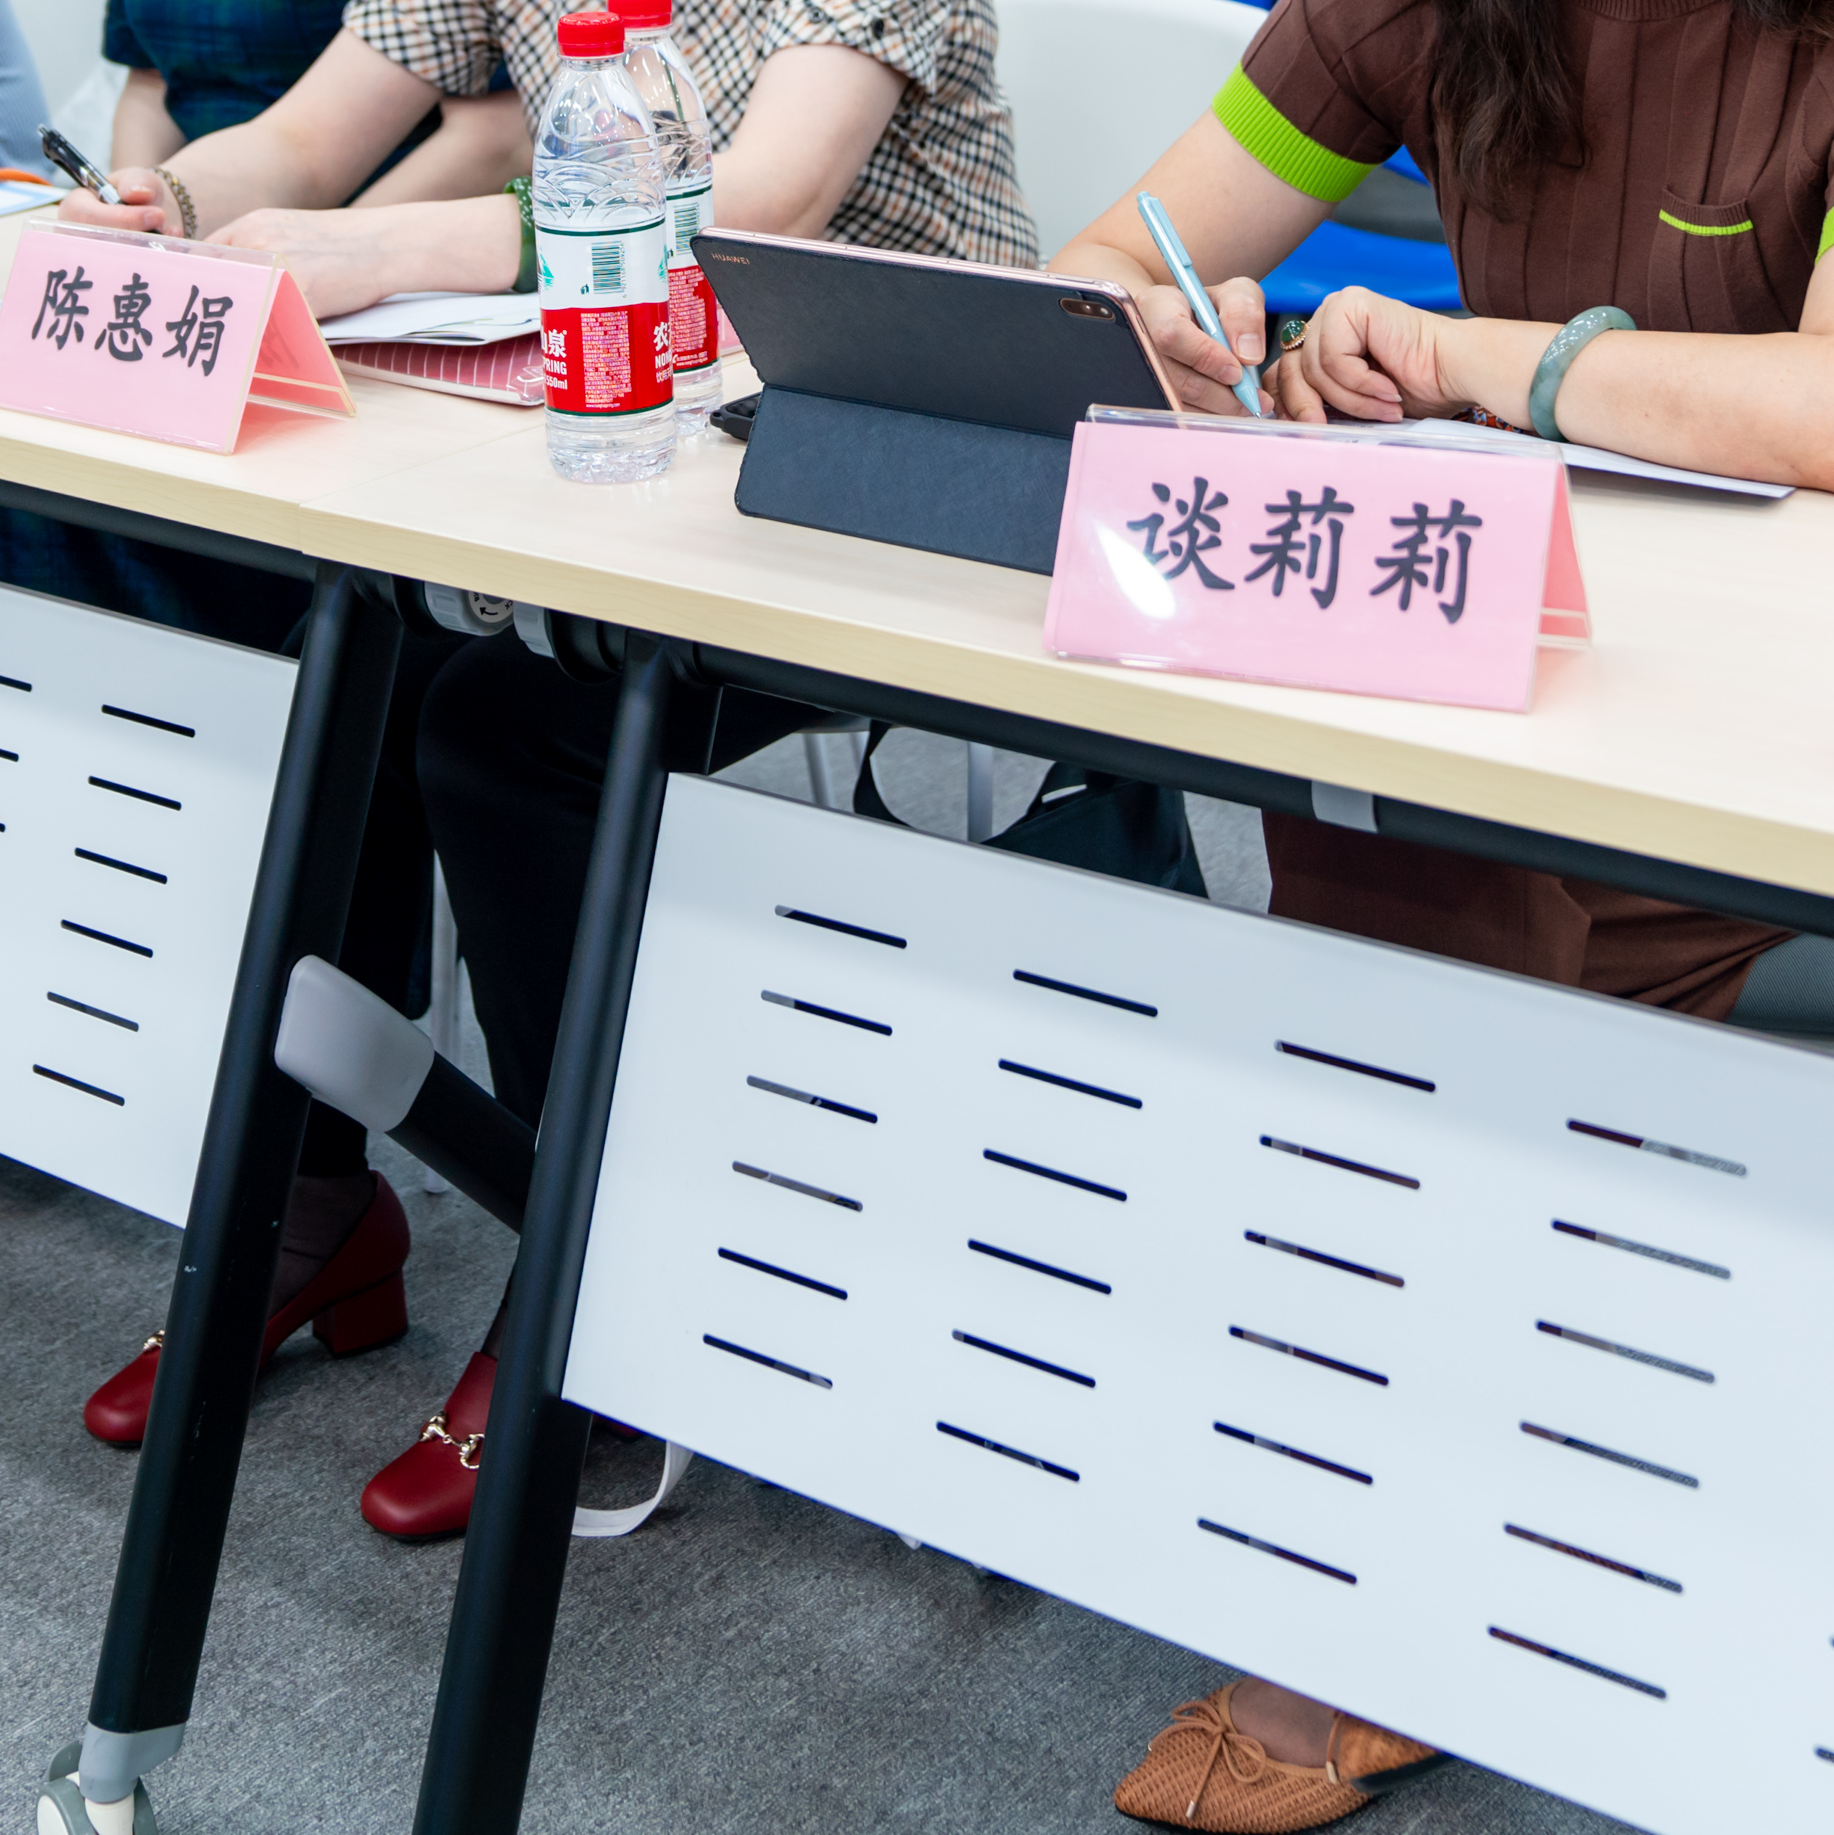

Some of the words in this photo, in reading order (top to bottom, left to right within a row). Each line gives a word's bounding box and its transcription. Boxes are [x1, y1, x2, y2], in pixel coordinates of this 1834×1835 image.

[711, 252, 750, 265] HUAWEI
[31, 265, 234, 378] 陈惠娟
[543, 356, 567, 376] PRING
[1127, 476, 1483, 624] 谈莉莉
